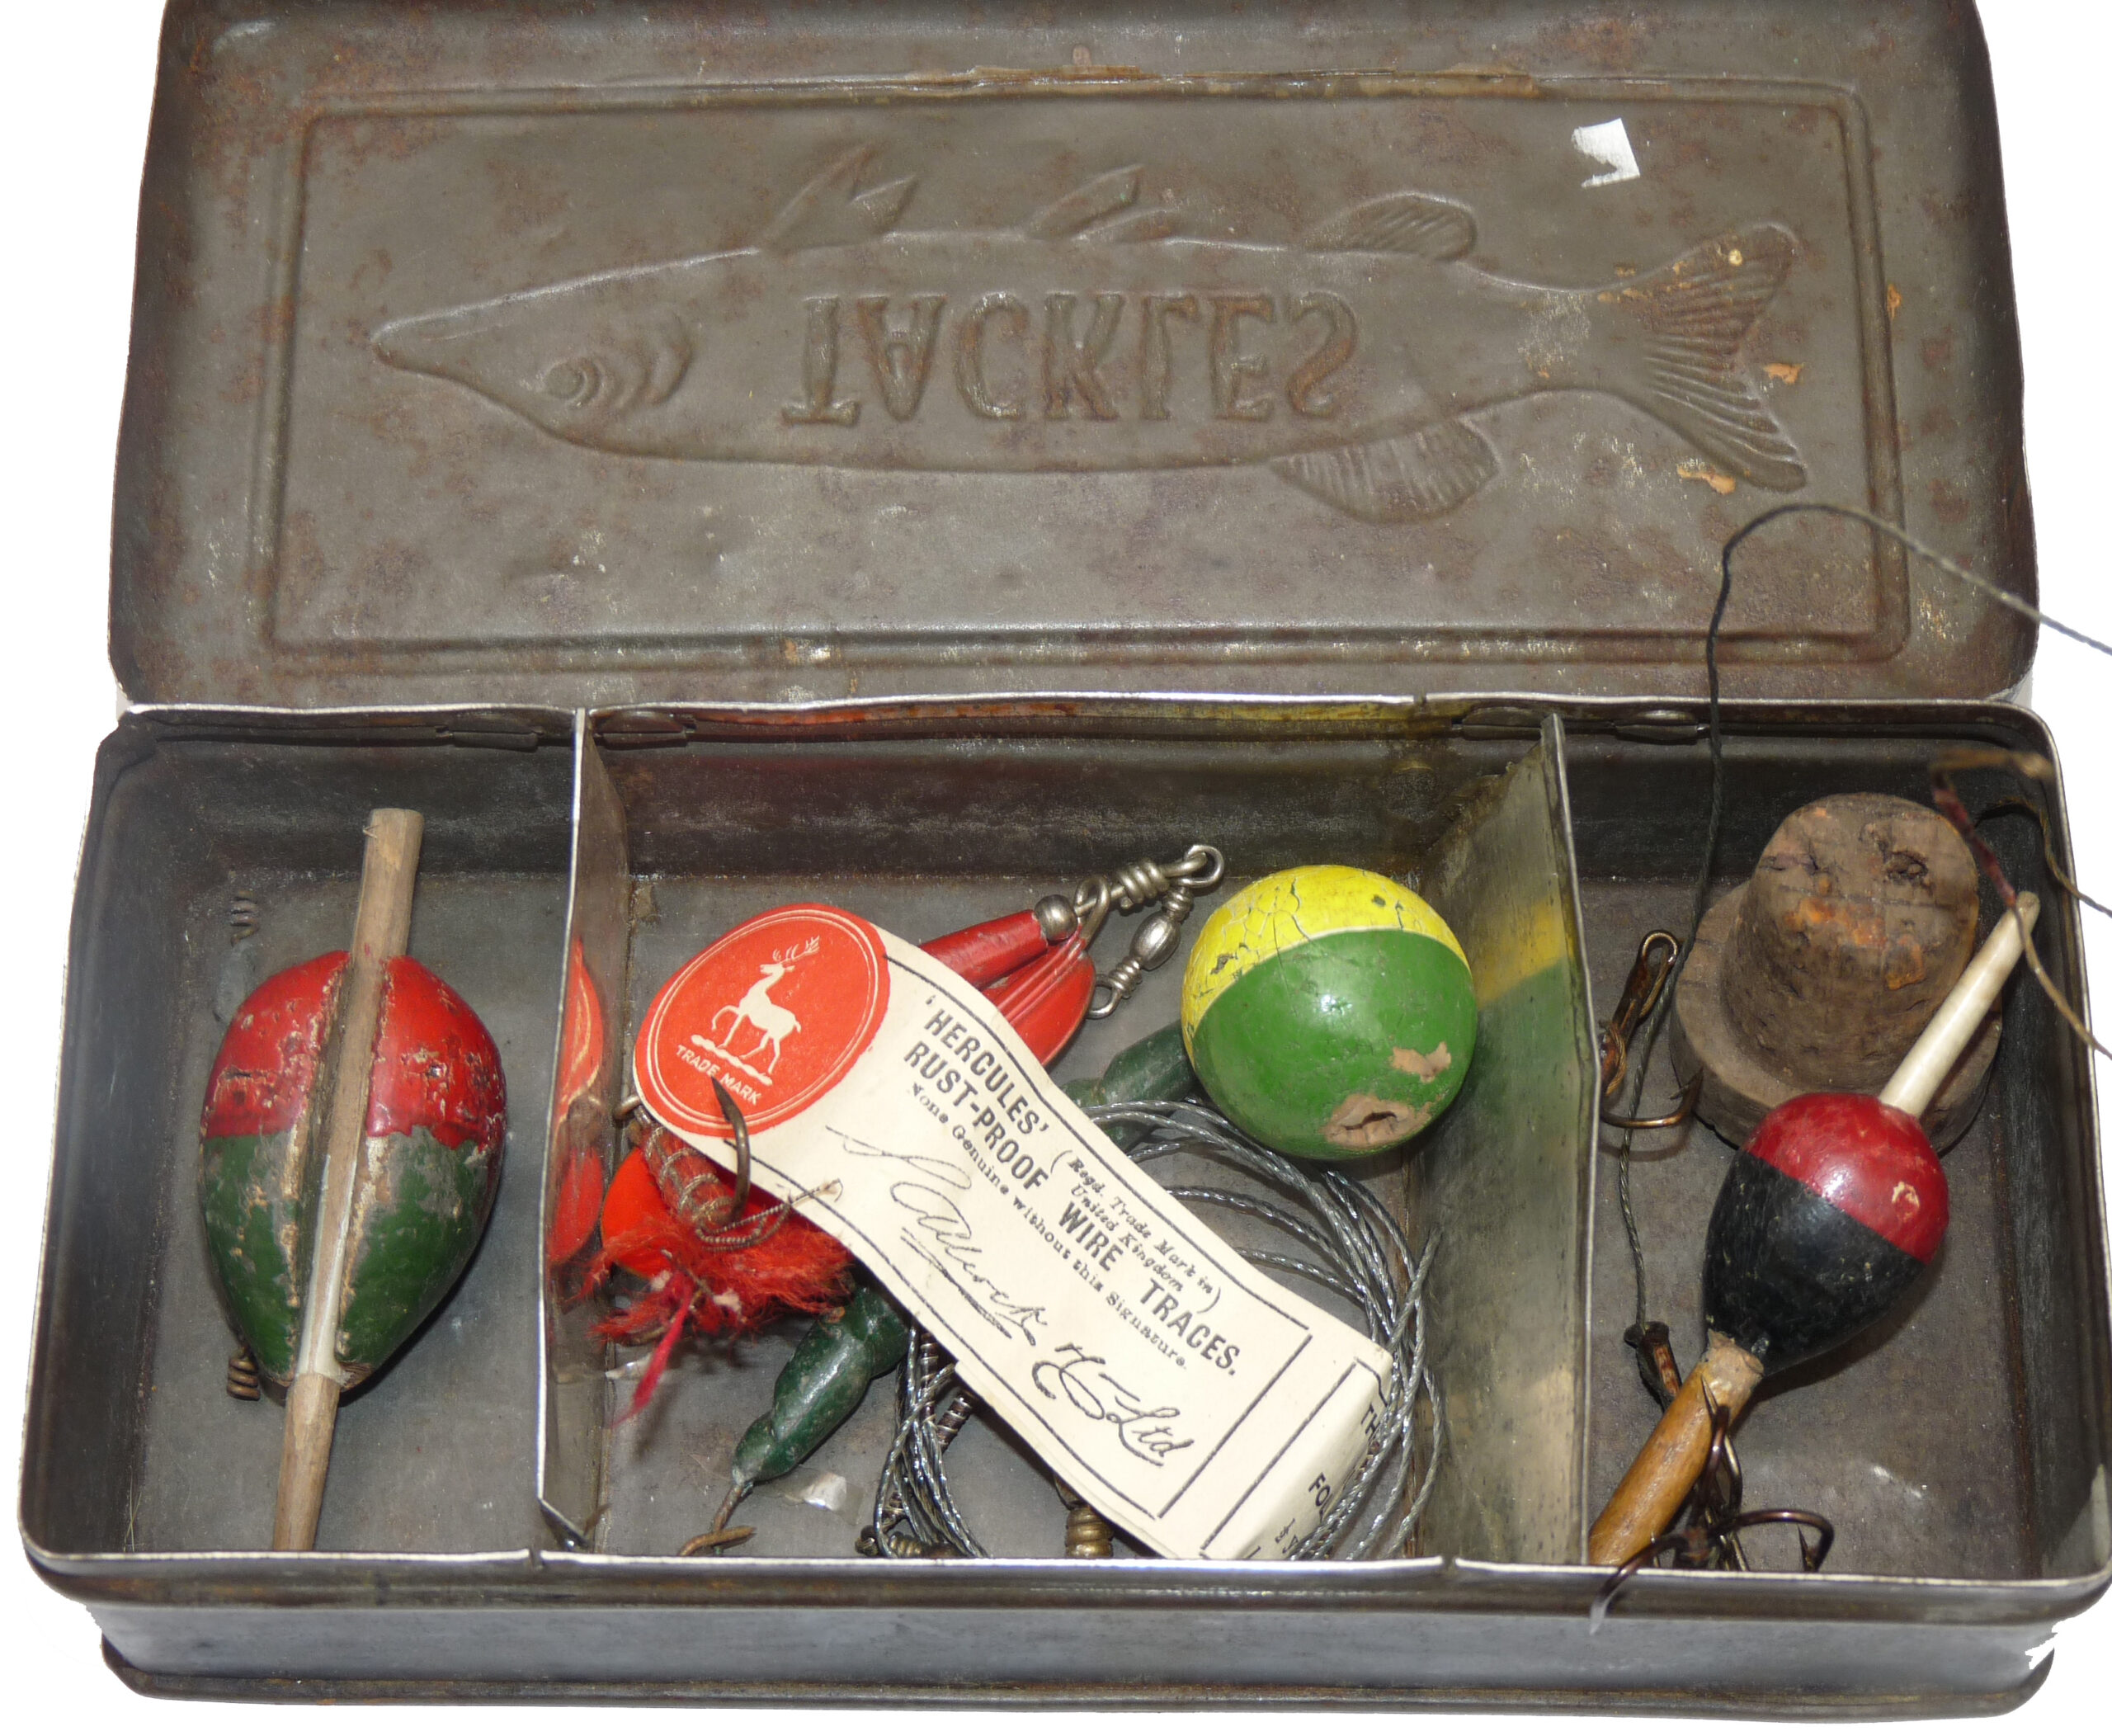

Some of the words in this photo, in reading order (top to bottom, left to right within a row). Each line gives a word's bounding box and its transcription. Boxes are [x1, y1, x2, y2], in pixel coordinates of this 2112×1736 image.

[676, 1045, 720, 1077] TRADE
[719, 1073, 761, 1106] MARK
[903, 1040, 1049, 1190] RUST-PROOF
[1058, 1201, 1124, 1271] WIRE
[1140, 1277, 1240, 1375] TRACES.
[912, 1082, 949, 1124] None
[952, 1125, 1009, 1195] Genuine
[1012, 1196, 1072, 1259] without
[1072, 1259, 1104, 1292] this
[1071, 1183, 1120, 1231] United
[1118, 1232, 1183, 1292] Kingdom
[1110, 1196, 1152, 1238] Trade
[1153, 1238, 1196, 1277] Mark
